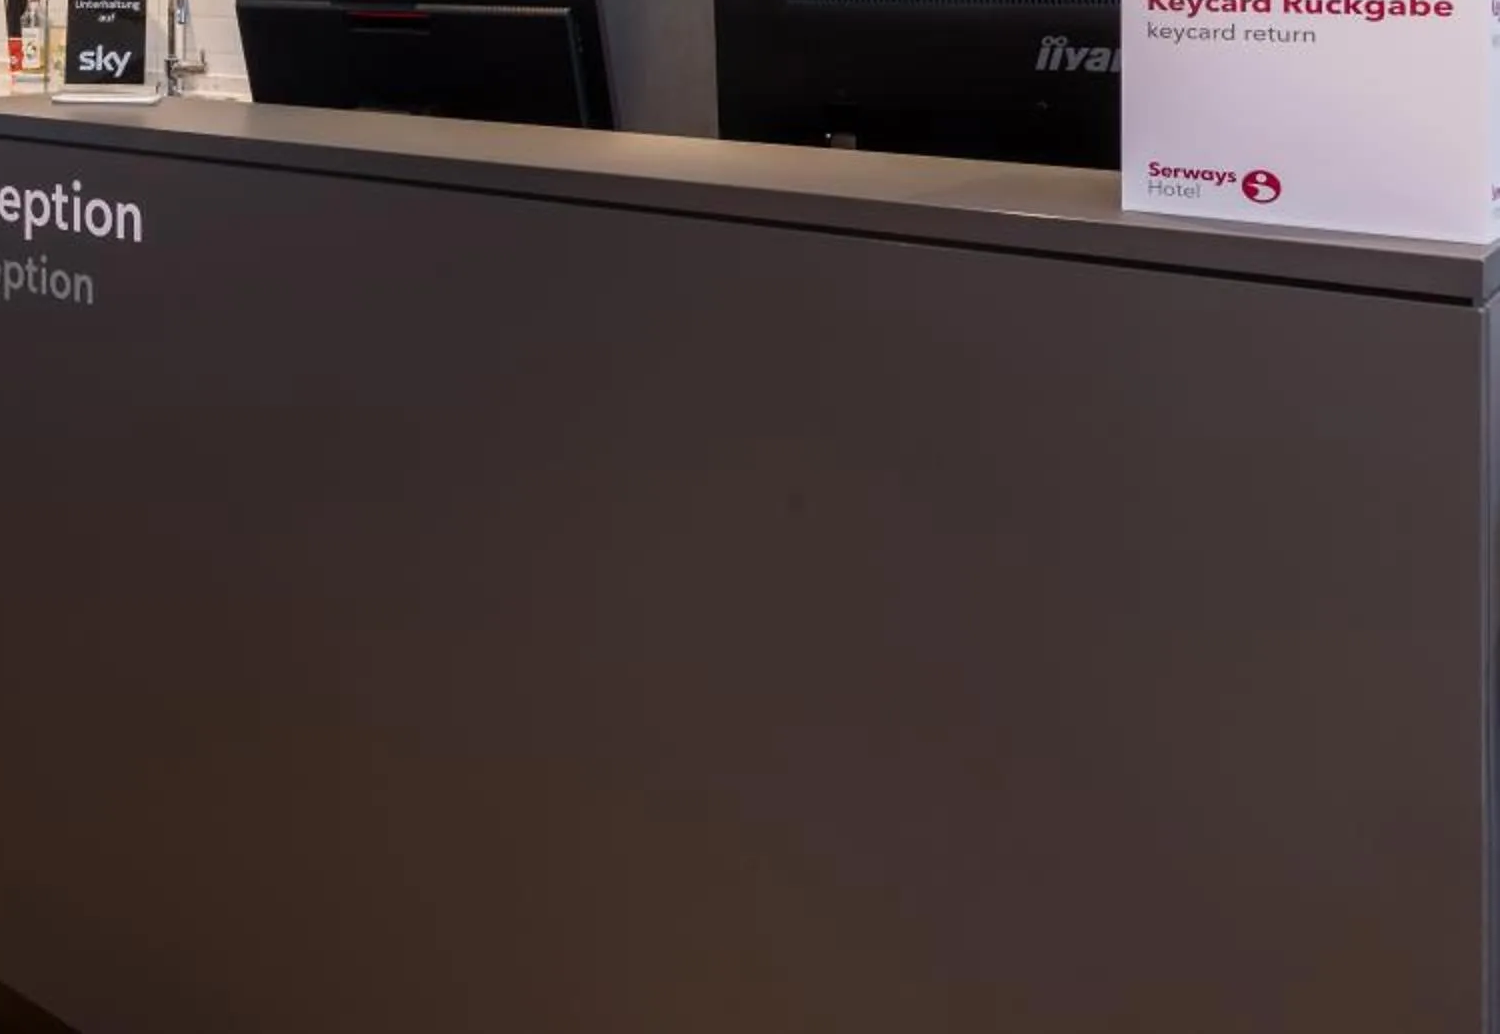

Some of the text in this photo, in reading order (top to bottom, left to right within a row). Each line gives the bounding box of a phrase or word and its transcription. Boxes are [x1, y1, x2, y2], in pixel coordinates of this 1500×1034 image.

[75, 0, 140, 12] Unterhaltung
[98, 13, 115, 23] auf
[1147, 22, 1316, 45] keycard return
[79, 44, 132, 78] sky
[1035, 35, 1121, 73] iiya
[1148, 161, 1237, 184] Serways
[1148, 179, 1202, 199] Hotel
